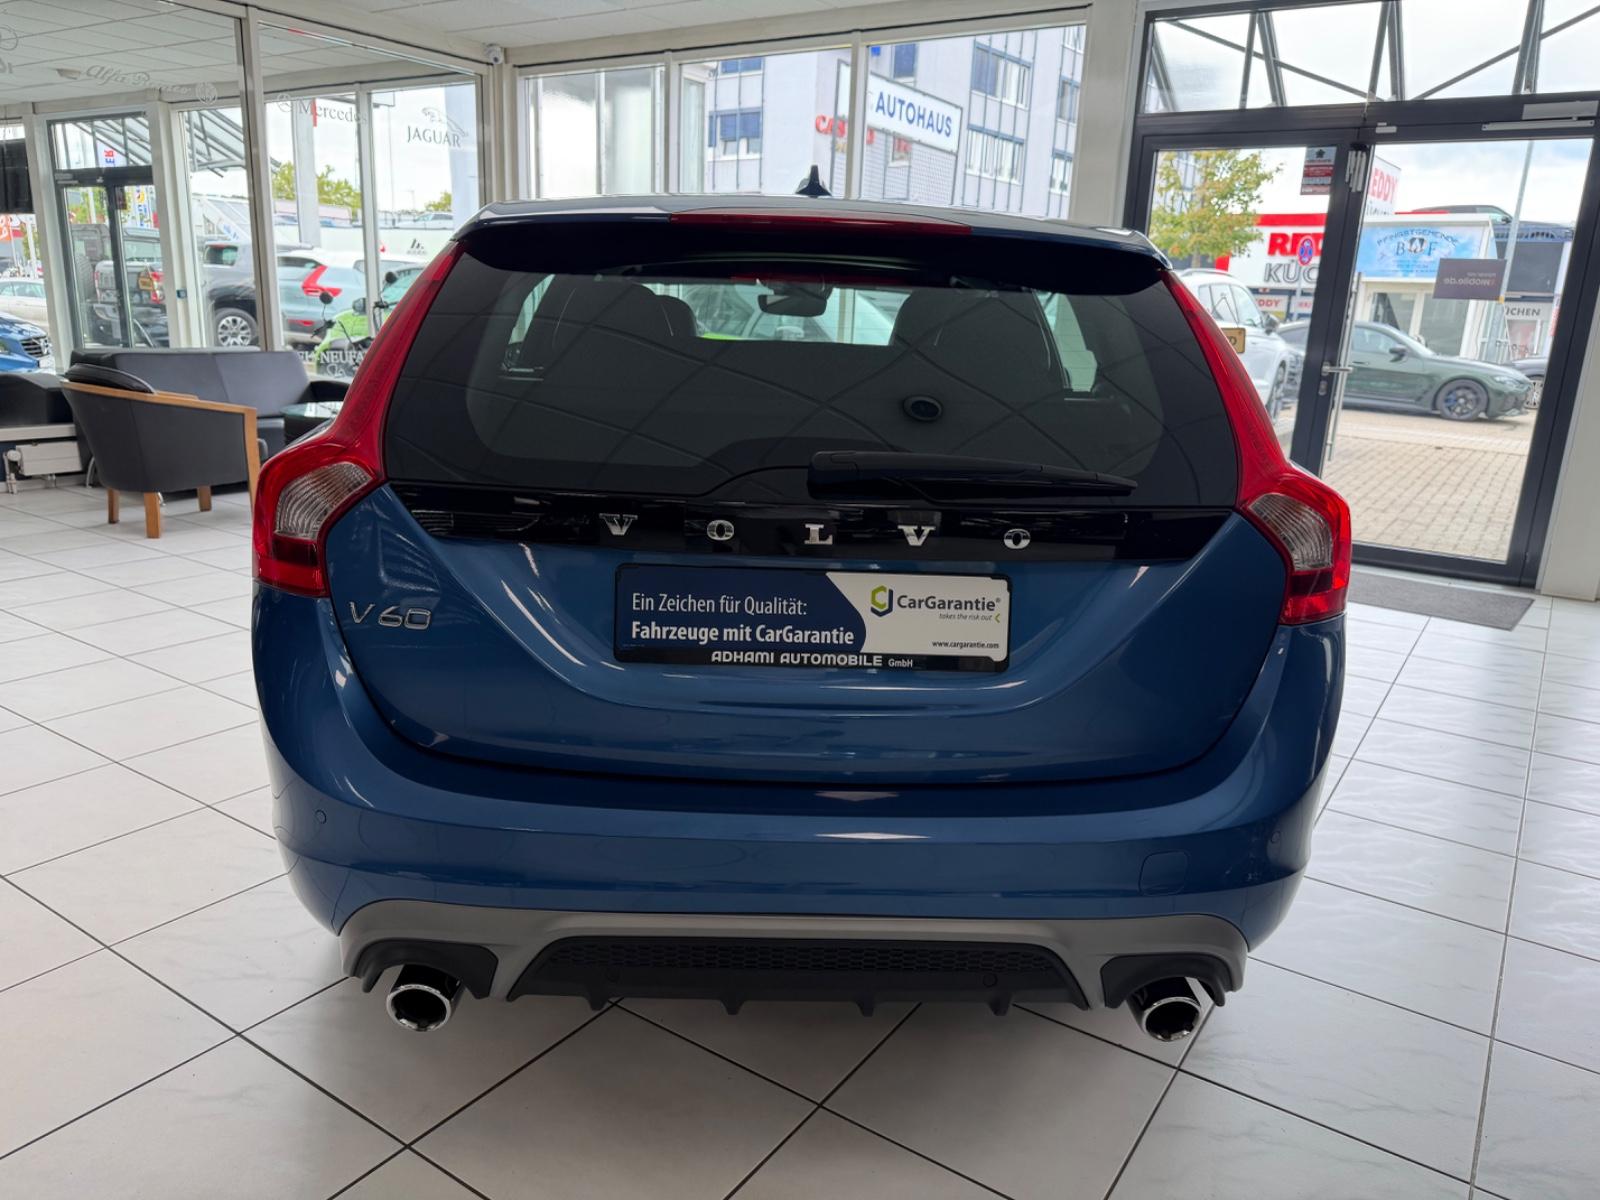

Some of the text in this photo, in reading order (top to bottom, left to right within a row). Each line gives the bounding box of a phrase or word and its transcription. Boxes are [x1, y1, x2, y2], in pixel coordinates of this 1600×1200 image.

[299, 100, 368, 125] Mercedes
[875, 91, 953, 138] AUTOHAUS
[407, 125, 462, 148] JAGUAR
[1369, 166, 1399, 204] EDDY
[1263, 259, 1320, 284] KÜC
[600, 512, 1031, 550] VOLVO
[631, 592, 808, 616] Ein Zeichen für Qualität:
[939, 612, 956, 620] takes
[957, 613, 968, 621] the
[969, 613, 980, 621] risk
[631, 620, 855, 645] Fahrzeuge mit CarGarantie
[931, 640, 999, 650] www.cargarantie.com
[711, 650, 914, 668] ADHAMI AUTOMOBILE GmbH
